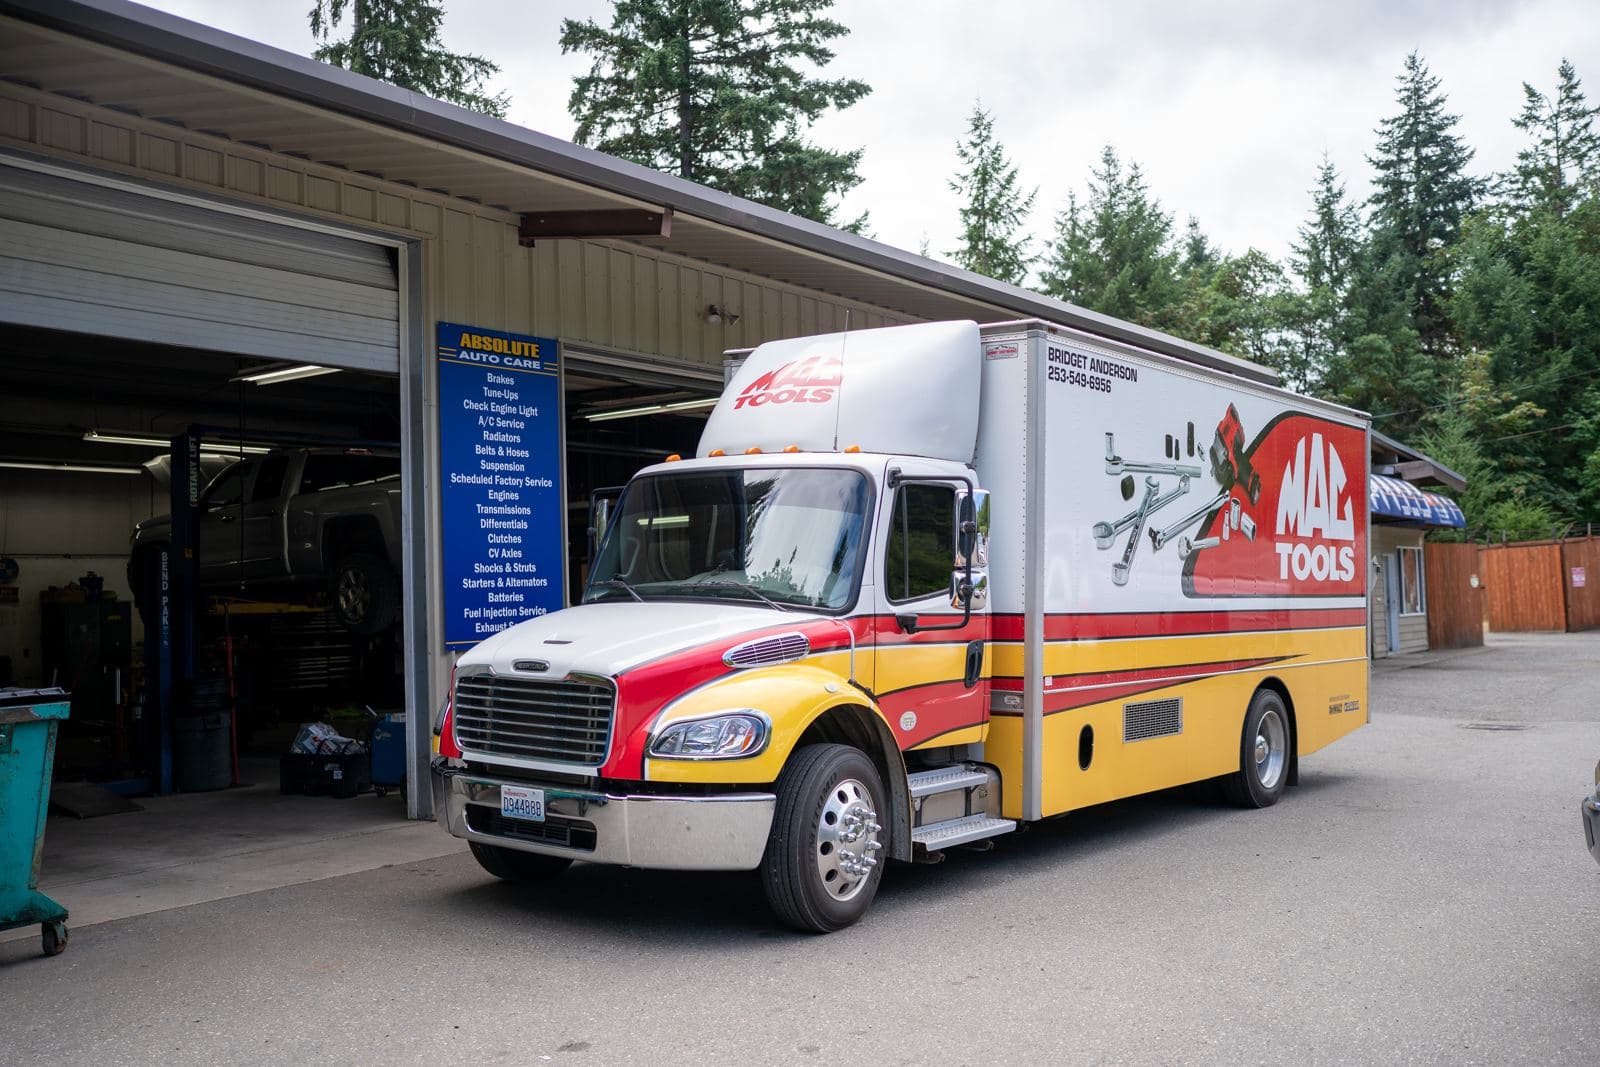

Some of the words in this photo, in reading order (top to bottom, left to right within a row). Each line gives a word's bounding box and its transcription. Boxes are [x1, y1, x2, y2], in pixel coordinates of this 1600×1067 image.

[460, 332, 540, 358] ABSOLUTE
[459, 350, 500, 364] AUTO
[503, 357, 541, 369] CARE
[1048, 346, 1088, 370] BRIDGET
[1089, 355, 1138, 382] ANDERSON
[487, 373, 515, 385] Brakes
[1048, 365, 1112, 393] 253-549-6956
[483, 387, 519, 401] Tune-Ups
[734, 388, 834, 410] TOOLS
[463, 399, 489, 412] Check
[490, 402, 517, 415] Engine
[519, 406, 539, 418] Light
[478, 415, 495, 428] A/C
[496, 417, 525, 429] Service
[483, 431, 521, 443] Radiators
[475, 444, 496, 456] Belts
[497, 446, 505, 456] &
[506, 446, 530, 458] Hoses
[480, 460, 525, 472] Suspension
[450, 473, 493, 485] Scheduled
[495, 475, 523, 488] Factory
[525, 476, 553, 487] Service
[1276, 432, 1355, 541] MAC
[488, 490, 519, 502] Engines
[476, 503, 531, 515] Transmissions
[480, 518, 528, 529] Differentials
[487, 533, 522, 544] Clutches
[488, 548, 500, 558] CV
[501, 548, 522, 558] Axles
[474, 563, 504, 573] Shocks
[505, 563, 512, 573] &
[513, 562, 537, 573] Struts
[1276, 542, 1355, 582] TOOLS
[462, 578, 496, 589] Starters
[497, 578, 504, 588] &
[505, 577, 548, 588] Alternators
[488, 592, 524, 603] Batteries
[464, 608, 482, 619] Fuel
[483, 606, 518, 620] Injection
[519, 605, 547, 616] Service
[475, 621, 507, 633] Exhaust
